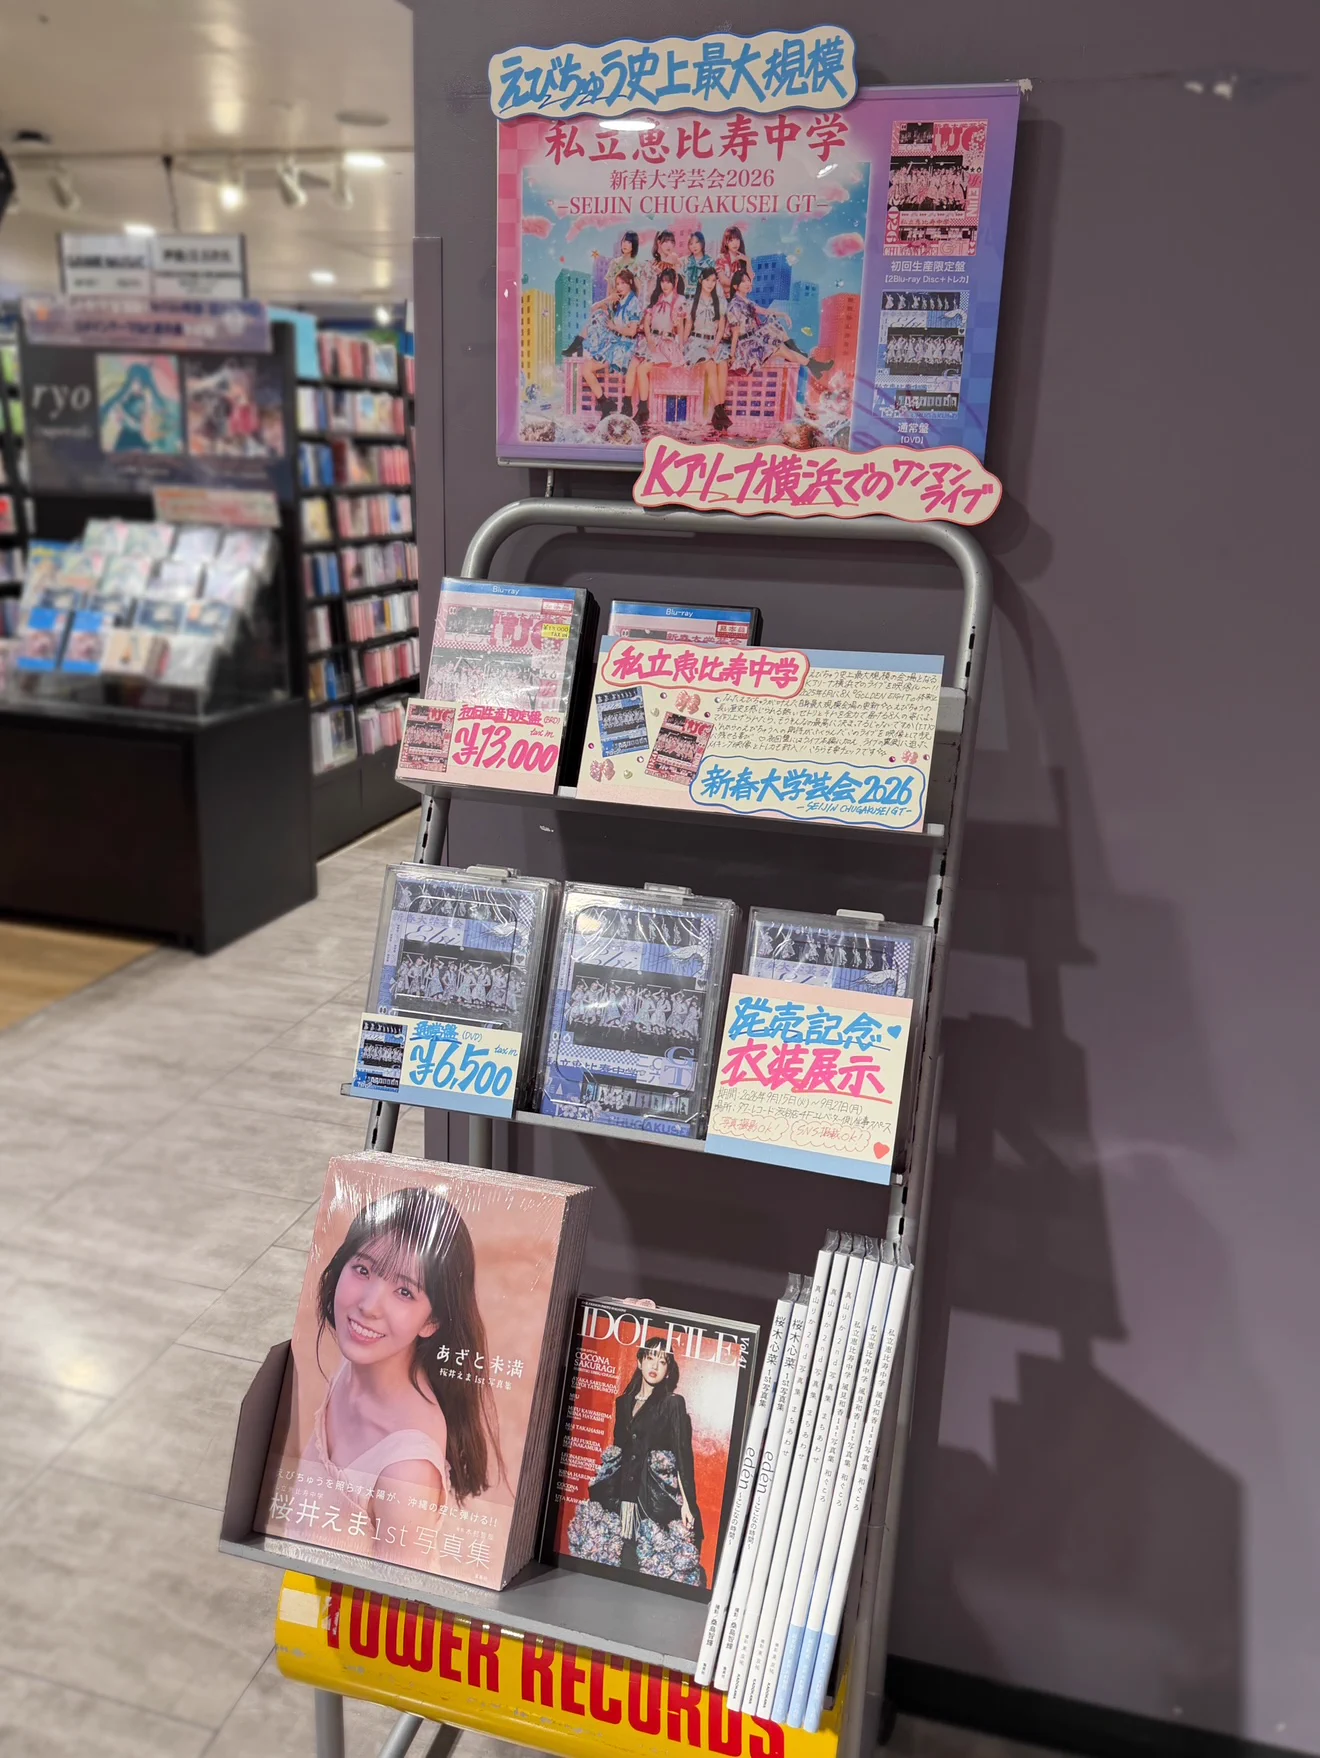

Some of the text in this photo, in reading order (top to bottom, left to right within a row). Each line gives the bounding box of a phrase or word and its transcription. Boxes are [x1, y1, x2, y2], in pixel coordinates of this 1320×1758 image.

[498, 36, 847, 107] えびちゅう史上最大規模
[545, 114, 848, 165] 私立恵比寿中学
[609, 167, 775, 190] 新春大学芸会2026
[638, 194, 777, 214] CHUGAKUSEI
[891, 261, 966, 273] 初回生産限定盤
[33, 384, 91, 421] ryo
[897, 423, 929, 434] 通常盤
[641, 445, 889, 506] Kアリーナ横浜での
[920, 481, 993, 515] ライブ
[492, 586, 520, 596] Blu-ray
[665, 607, 694, 618] Blu-ray
[612, 645, 799, 689] 私立恵比寿中学
[452, 723, 559, 773] ¥13,000
[701, 764, 914, 805] 新春大学芸会2026
[840, 804, 889, 815] CHUGAKUSEI
[462, 1031, 483, 1042] (DVD)
[728, 997, 883, 1051] 発売記念
[409, 1037, 513, 1096] ¥6,500
[721, 1039, 885, 1097] 衣装展示
[574, 1351, 610, 1364] COCONA
[577, 1306, 741, 1367] IDOL FILE
[767, 1315, 786, 1365] 桜木心菜
[783, 1318, 804, 1369] 桜木心菜
[844, 1320, 861, 1378] 私立恵比寿中学
[861, 1325, 878, 1383] 私立恵比寿中学
[879, 1328, 895, 1387] 私立恵比寿中学
[437, 1345, 524, 1378] あざと未満
[573, 1359, 615, 1373] SAKURAGI
[327, 1582, 500, 1693] TOWER
[521, 1628, 785, 1758] RECORDS
